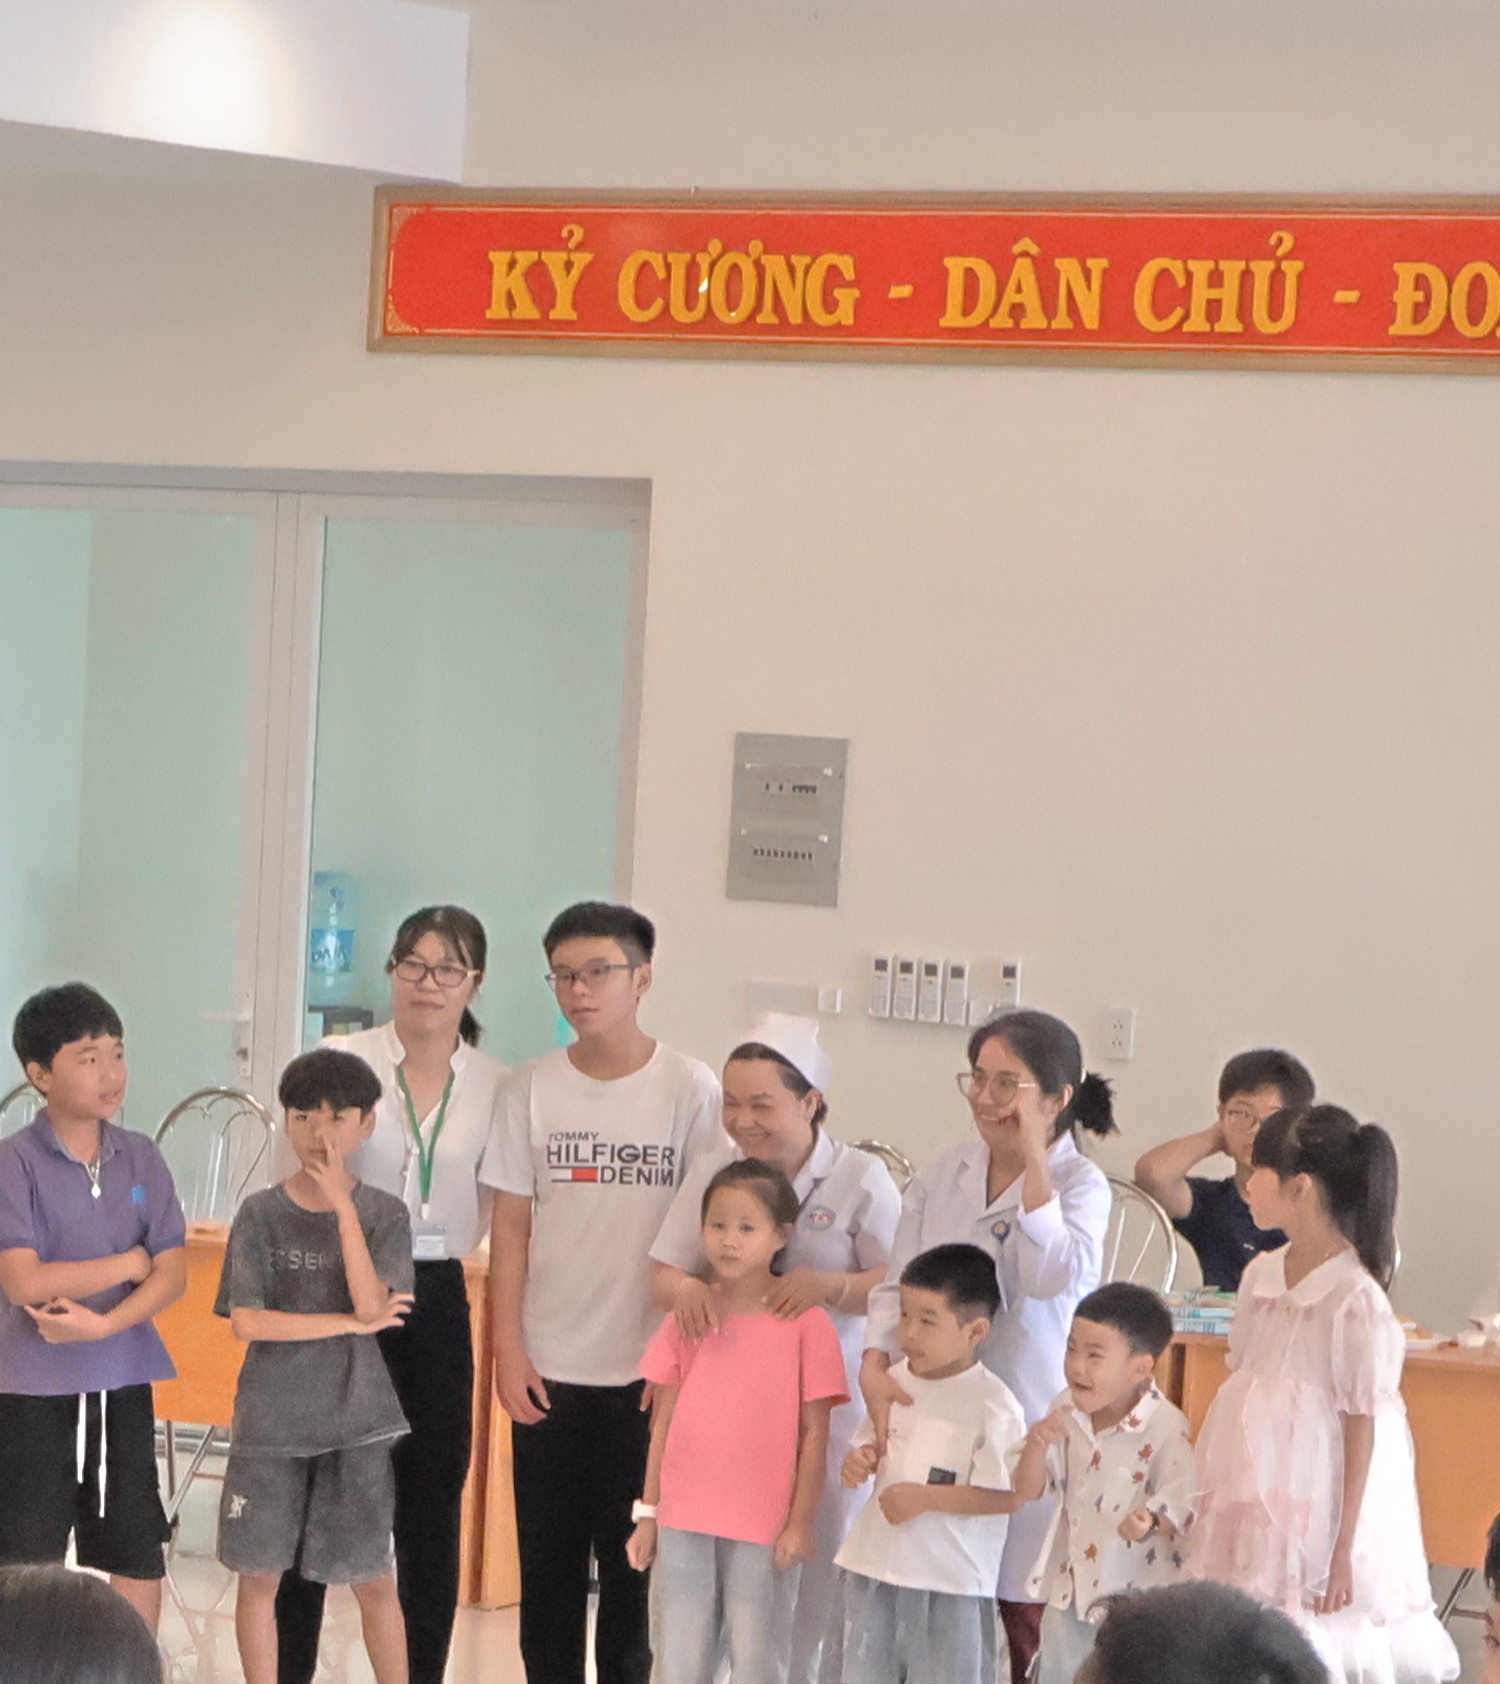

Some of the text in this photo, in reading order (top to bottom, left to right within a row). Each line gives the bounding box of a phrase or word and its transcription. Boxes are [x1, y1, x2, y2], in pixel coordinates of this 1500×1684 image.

[485, 224, 595, 321] KỶ
[618, 239, 861, 328] CƯƠNG
[939, 237, 1110, 330] DÂN
[1134, 231, 1305, 335] CHỦ
[546, 1143, 675, 1167] HILFIGER
